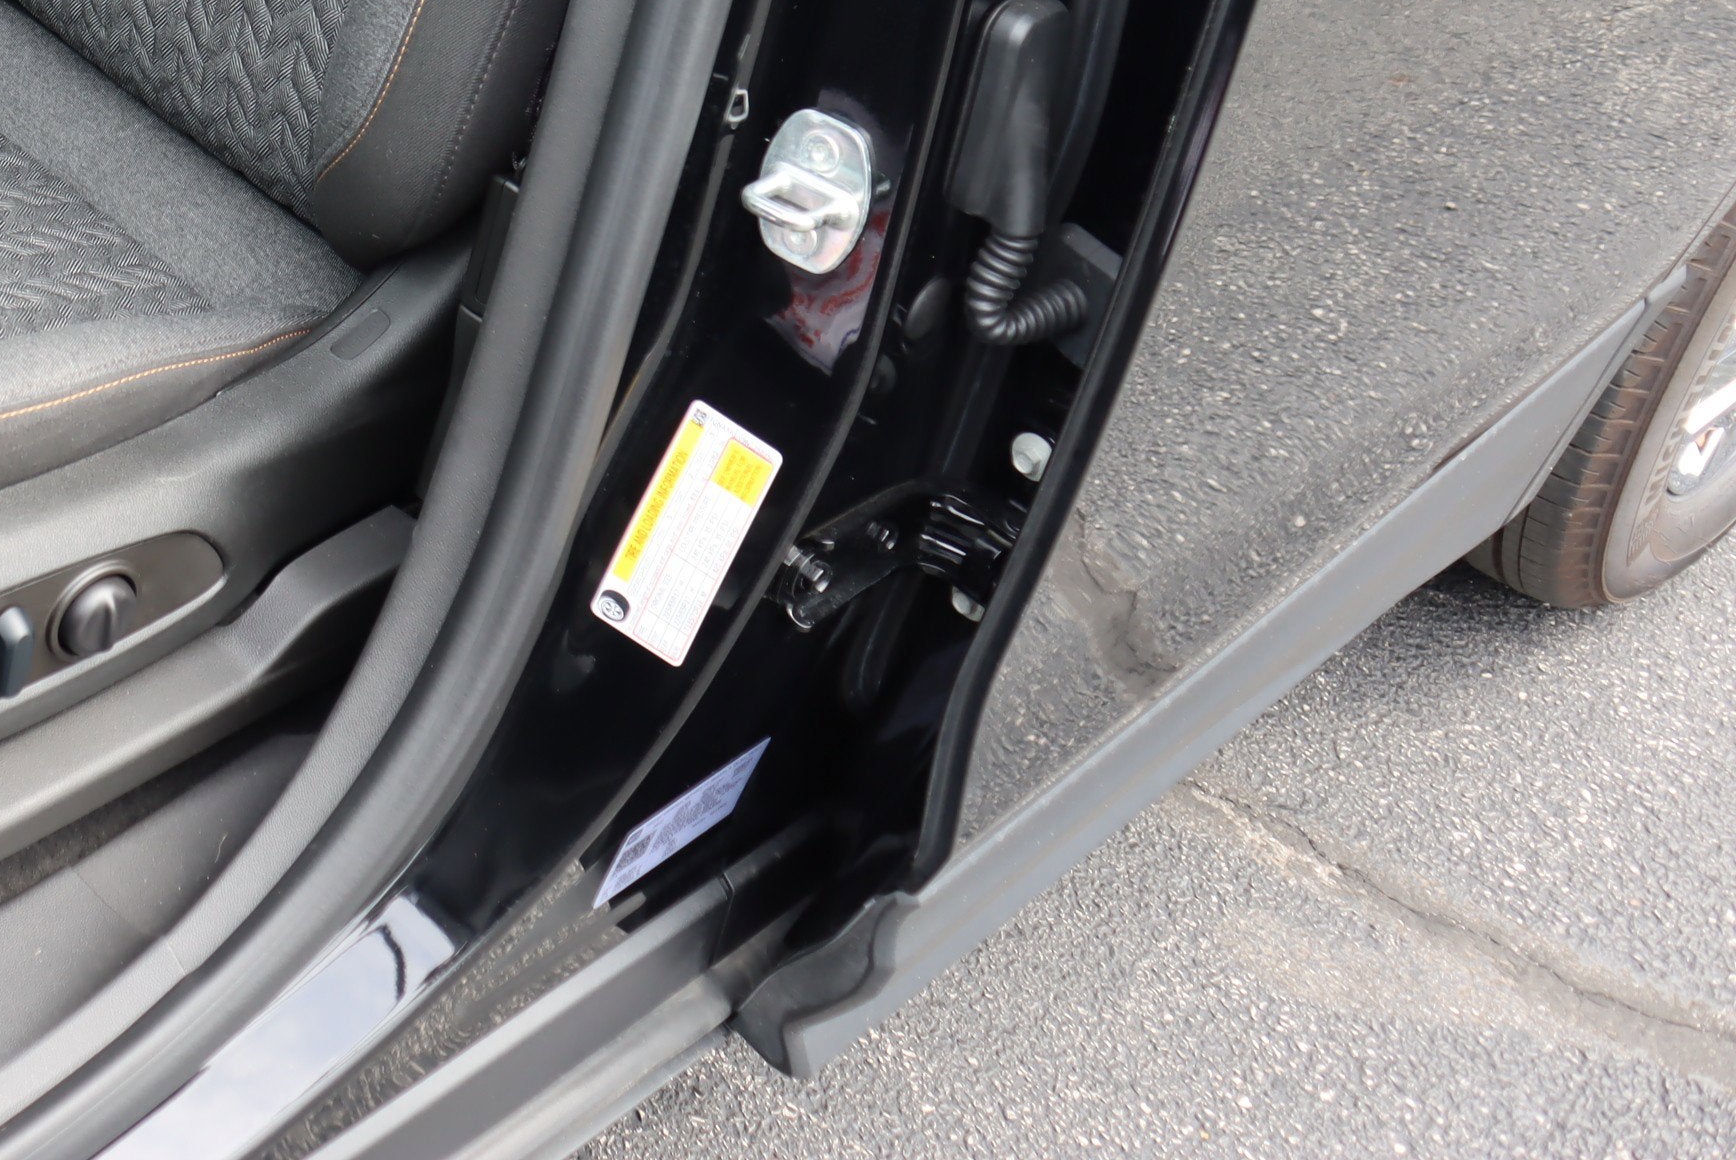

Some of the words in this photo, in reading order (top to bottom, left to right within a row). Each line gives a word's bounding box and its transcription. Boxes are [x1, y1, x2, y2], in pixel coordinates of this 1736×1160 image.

[633, 527, 649, 547] AND
[642, 496, 663, 529] LOADING
[657, 450, 689, 499] INFORMATION
